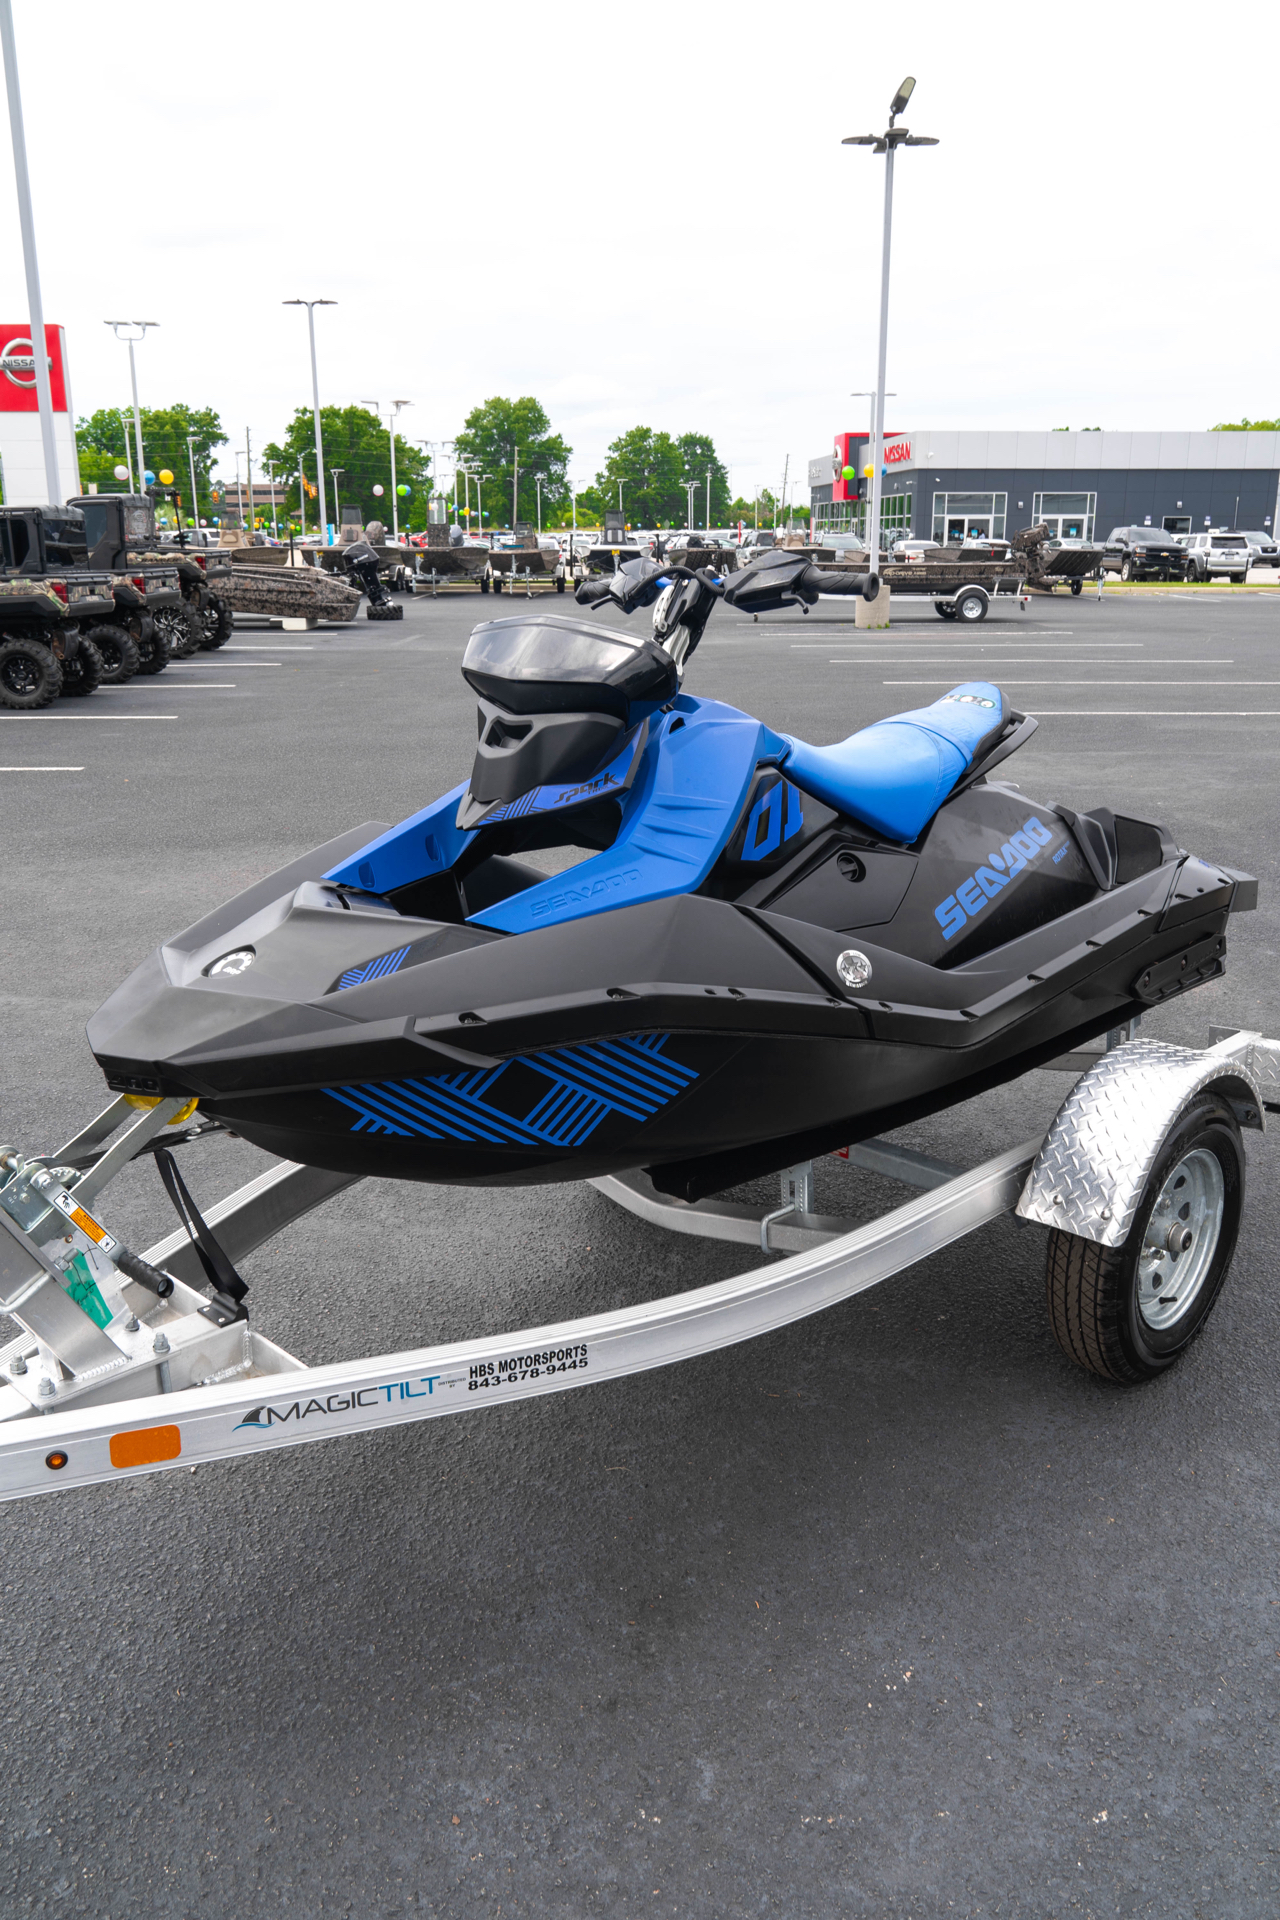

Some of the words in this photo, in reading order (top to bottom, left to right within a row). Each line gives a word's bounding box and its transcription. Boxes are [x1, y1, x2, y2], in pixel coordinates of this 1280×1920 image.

[2, 359, 36, 367] NISSA
[884, 441, 911, 464] NISSAN
[468, 1357, 589, 1391] 843-678-9445
[469, 1362, 495, 1379] HBS
[498, 1343, 588, 1373] MOTORSPORTS
